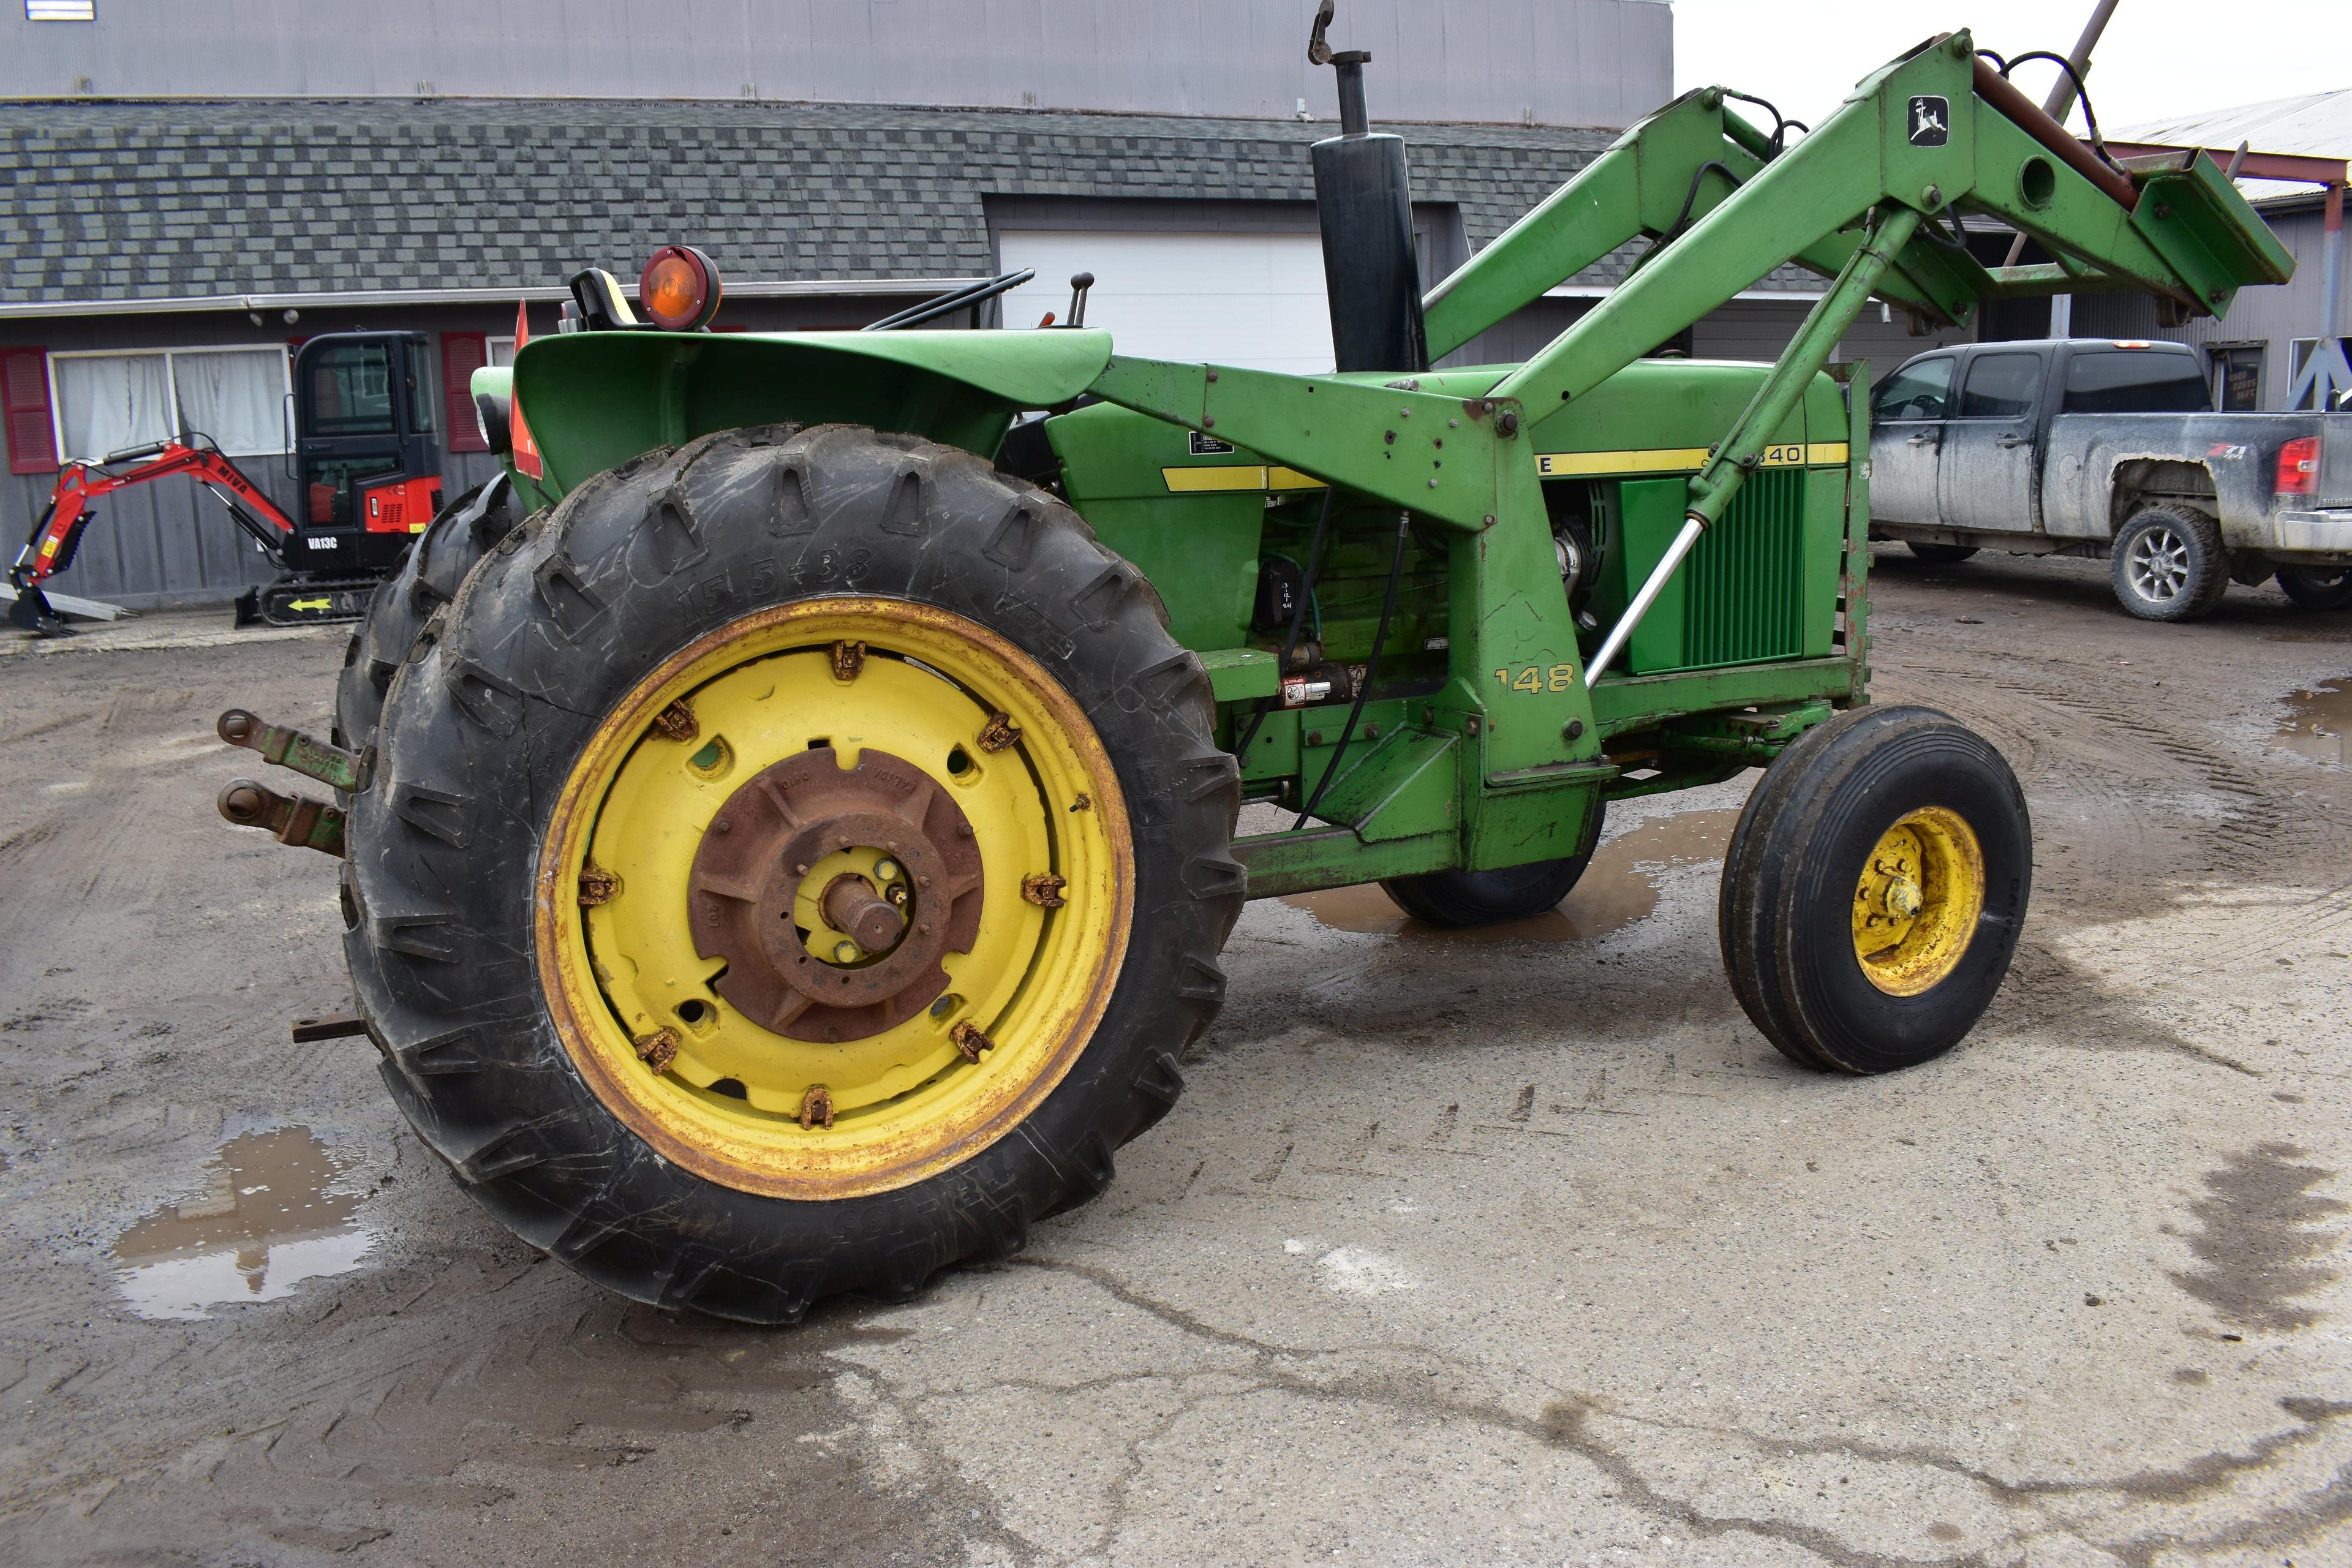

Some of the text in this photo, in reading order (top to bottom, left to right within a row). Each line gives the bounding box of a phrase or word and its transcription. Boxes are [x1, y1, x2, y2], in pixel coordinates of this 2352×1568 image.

[217, 466, 248, 494] MIVA
[307, 537, 337, 549] VA13C
[1494, 663, 1574, 695] 148
